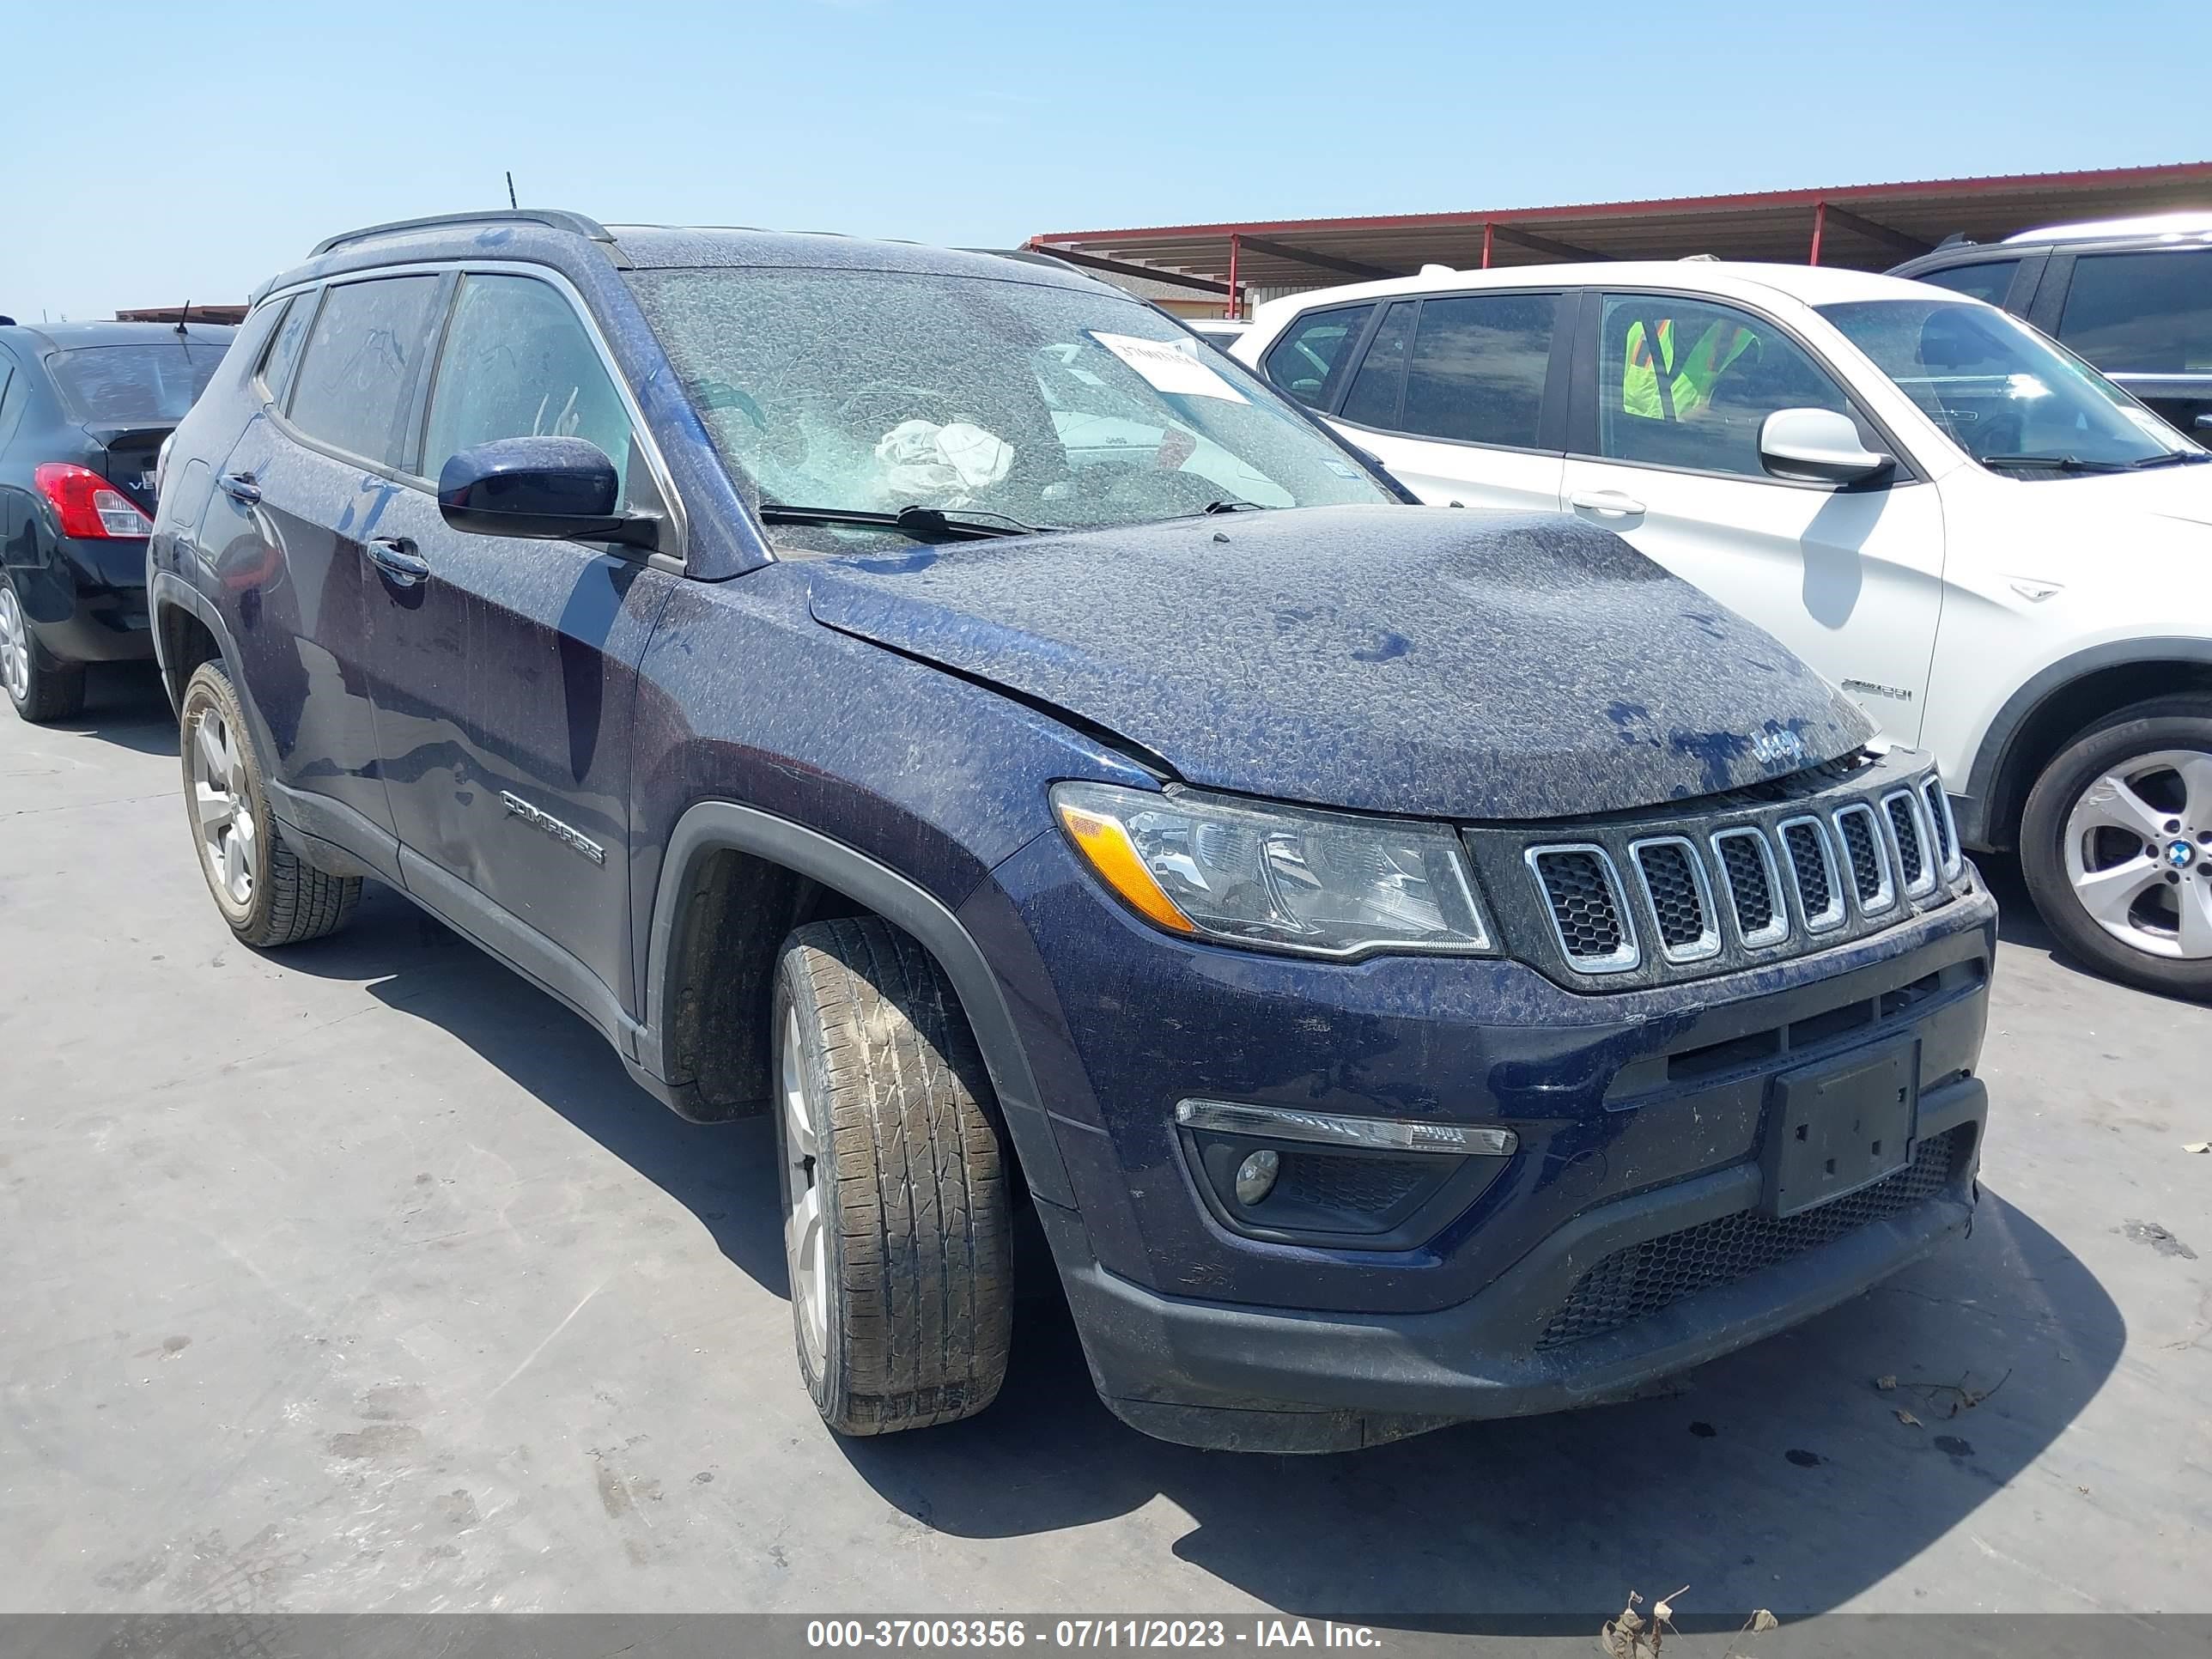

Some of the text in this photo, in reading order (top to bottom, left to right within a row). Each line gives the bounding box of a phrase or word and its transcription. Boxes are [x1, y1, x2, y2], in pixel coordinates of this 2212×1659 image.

[129, 482, 155, 490] VE
[1749, 730, 1802, 764] Jeep
[500, 789, 605, 865] COMPASS
